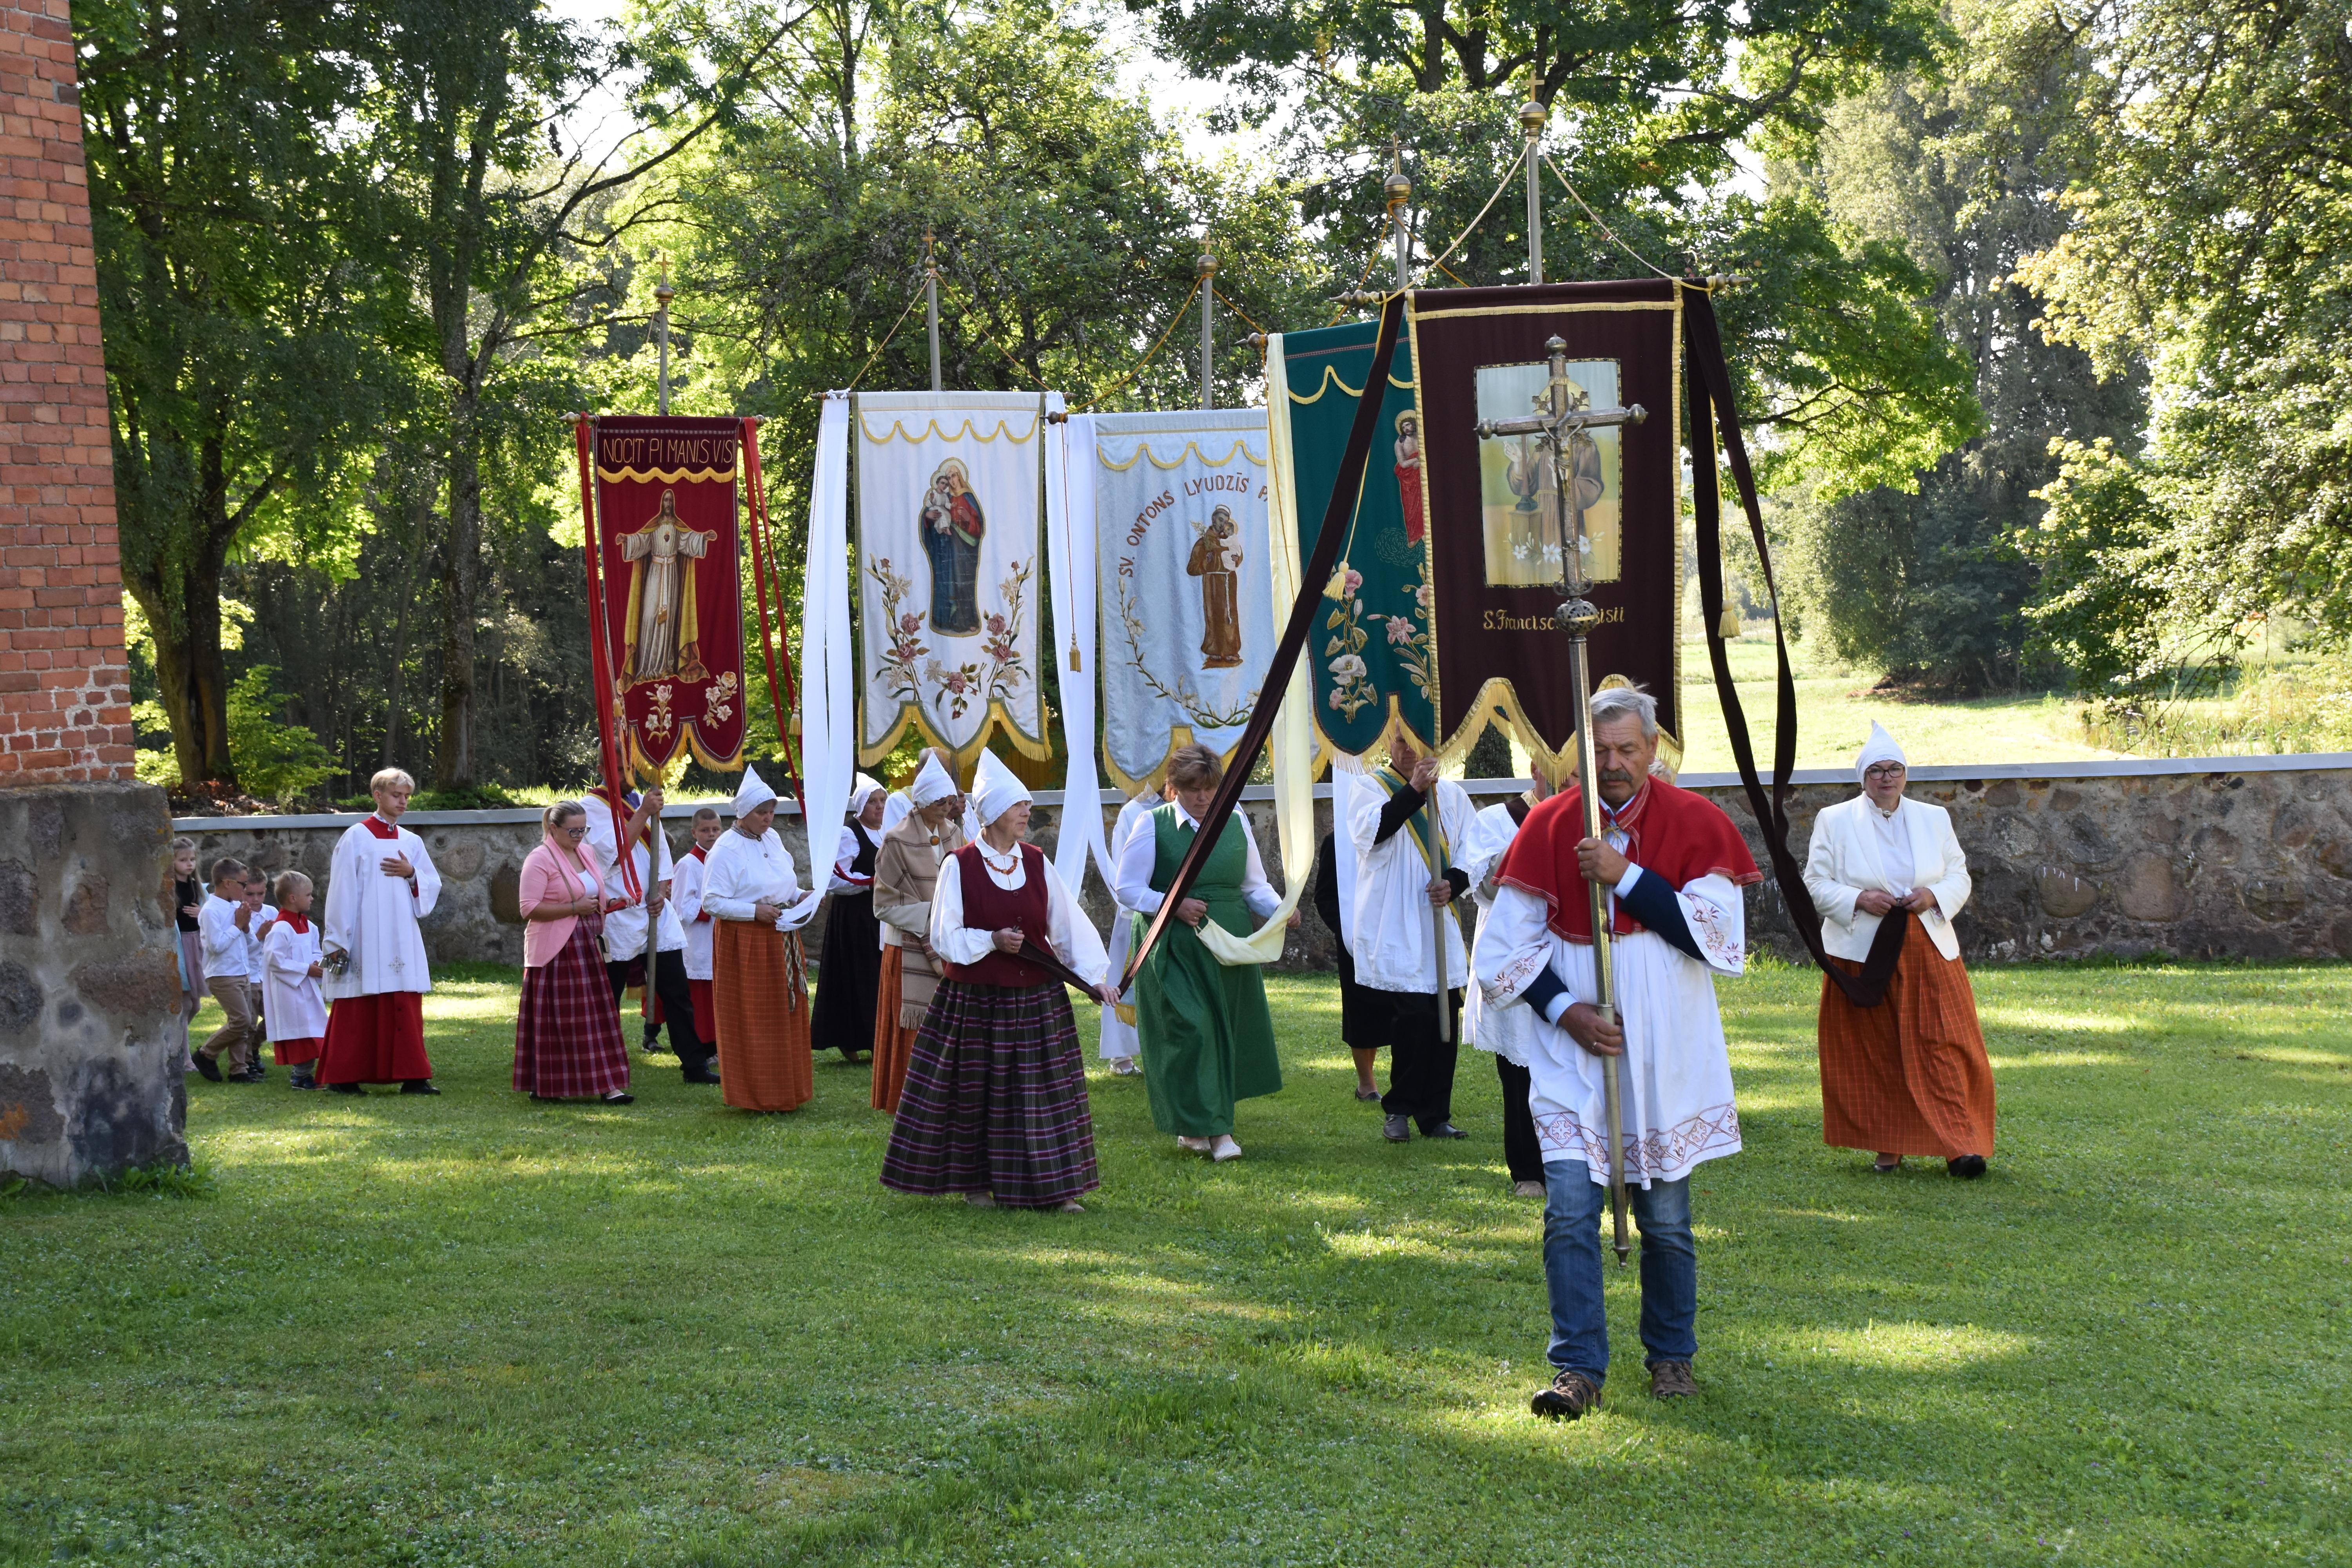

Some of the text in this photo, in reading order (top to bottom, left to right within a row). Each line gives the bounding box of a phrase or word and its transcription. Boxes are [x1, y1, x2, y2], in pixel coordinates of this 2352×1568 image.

[603, 438, 644, 463] NOCIT
[649, 438, 662, 463] PI
[667, 439, 710, 463] MANIS
[1184, 472, 1249, 496] LYUDZĪS
[1126, 490, 1174, 546] ONTONS
[1119, 556, 1135, 578] SV.
